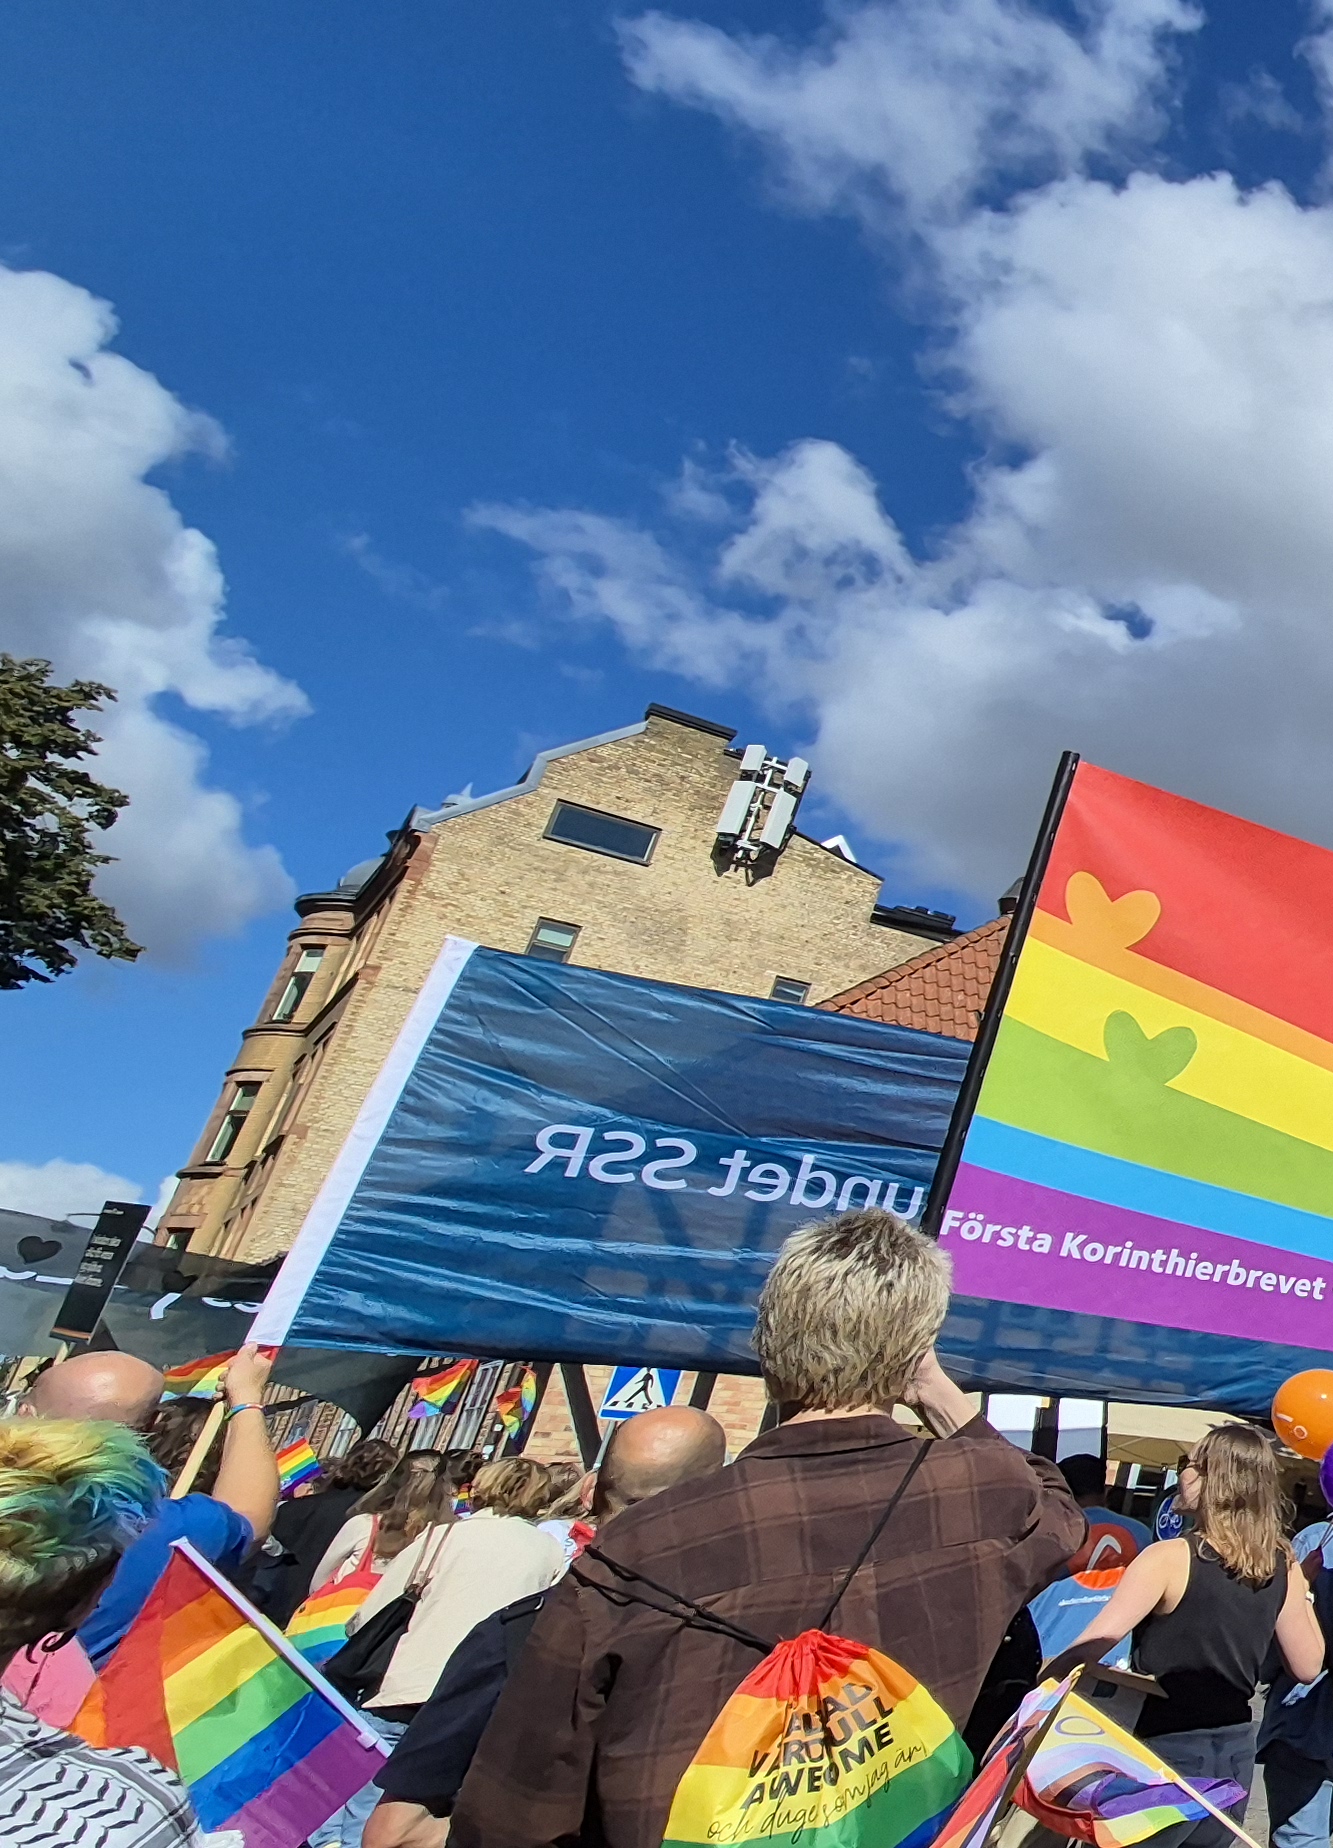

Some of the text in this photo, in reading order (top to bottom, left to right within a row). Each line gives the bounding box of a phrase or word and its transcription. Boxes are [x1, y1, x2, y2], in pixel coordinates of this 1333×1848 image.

[939, 1209, 1053, 1254] Första
[1059, 1232, 1326, 1301] Korinthierbrevet
[865, 1760, 890, 1808] jag
